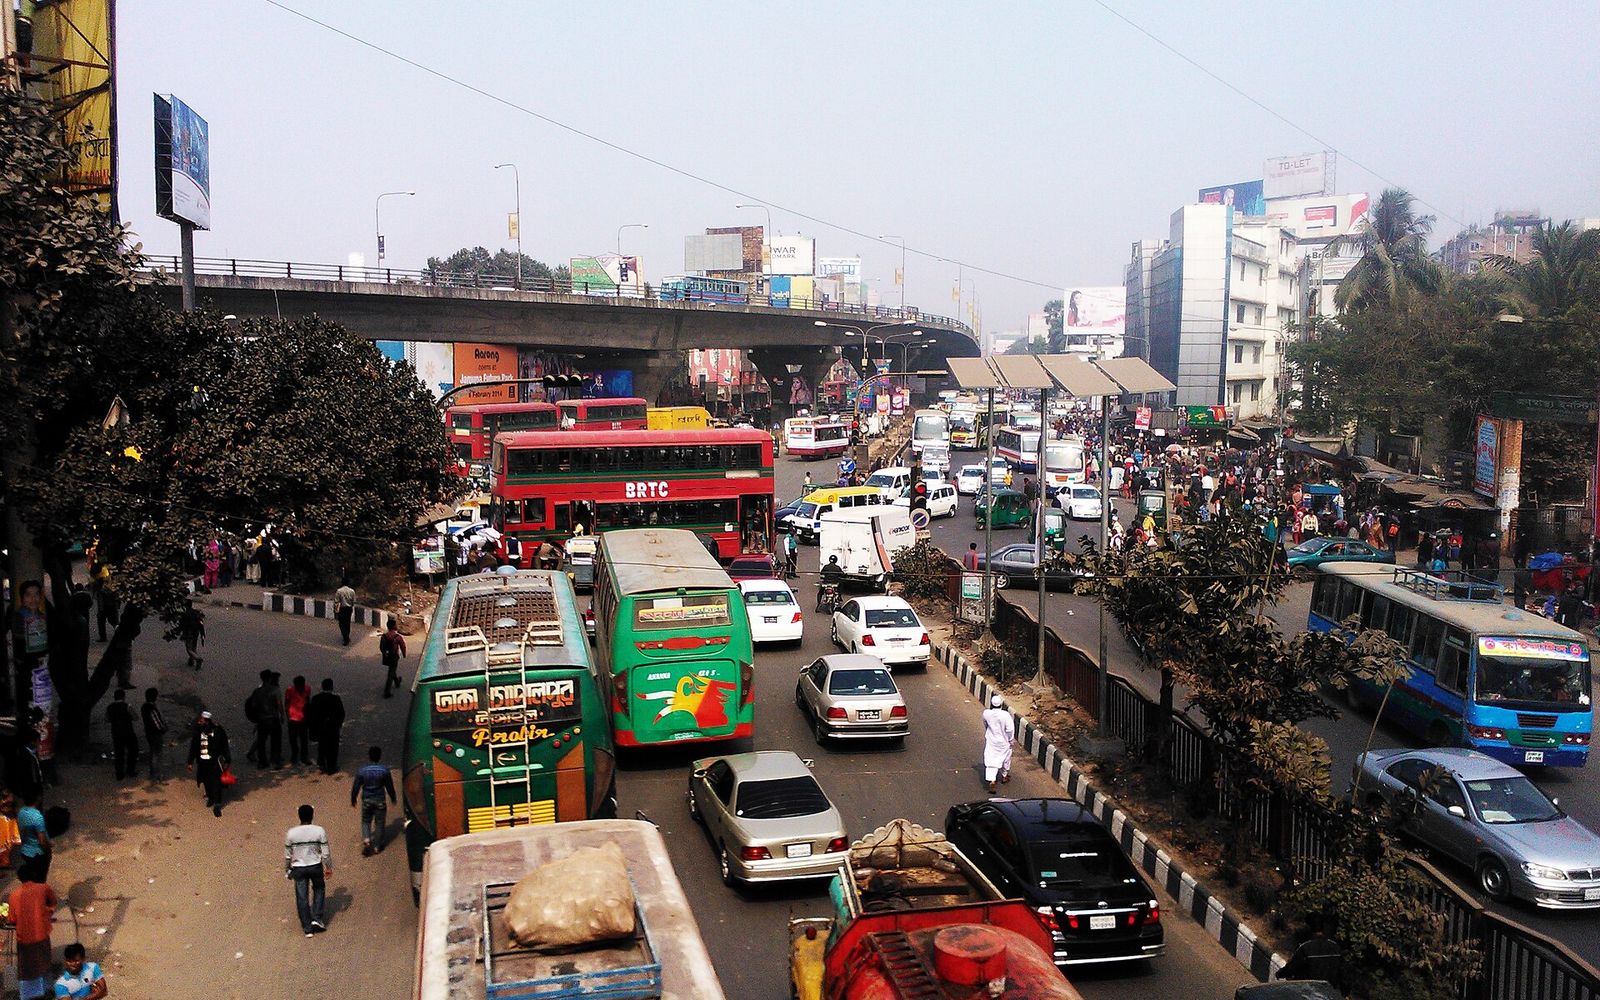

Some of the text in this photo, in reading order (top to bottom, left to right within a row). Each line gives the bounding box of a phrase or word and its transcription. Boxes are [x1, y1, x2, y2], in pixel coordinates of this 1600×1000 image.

[772, 246, 796, 254] WAR
[474, 348, 500, 363] Aarong
[472, 390, 491, 399] February
[625, 481, 669, 498] BRTC
[435, 688, 479, 713] ঢাকা
